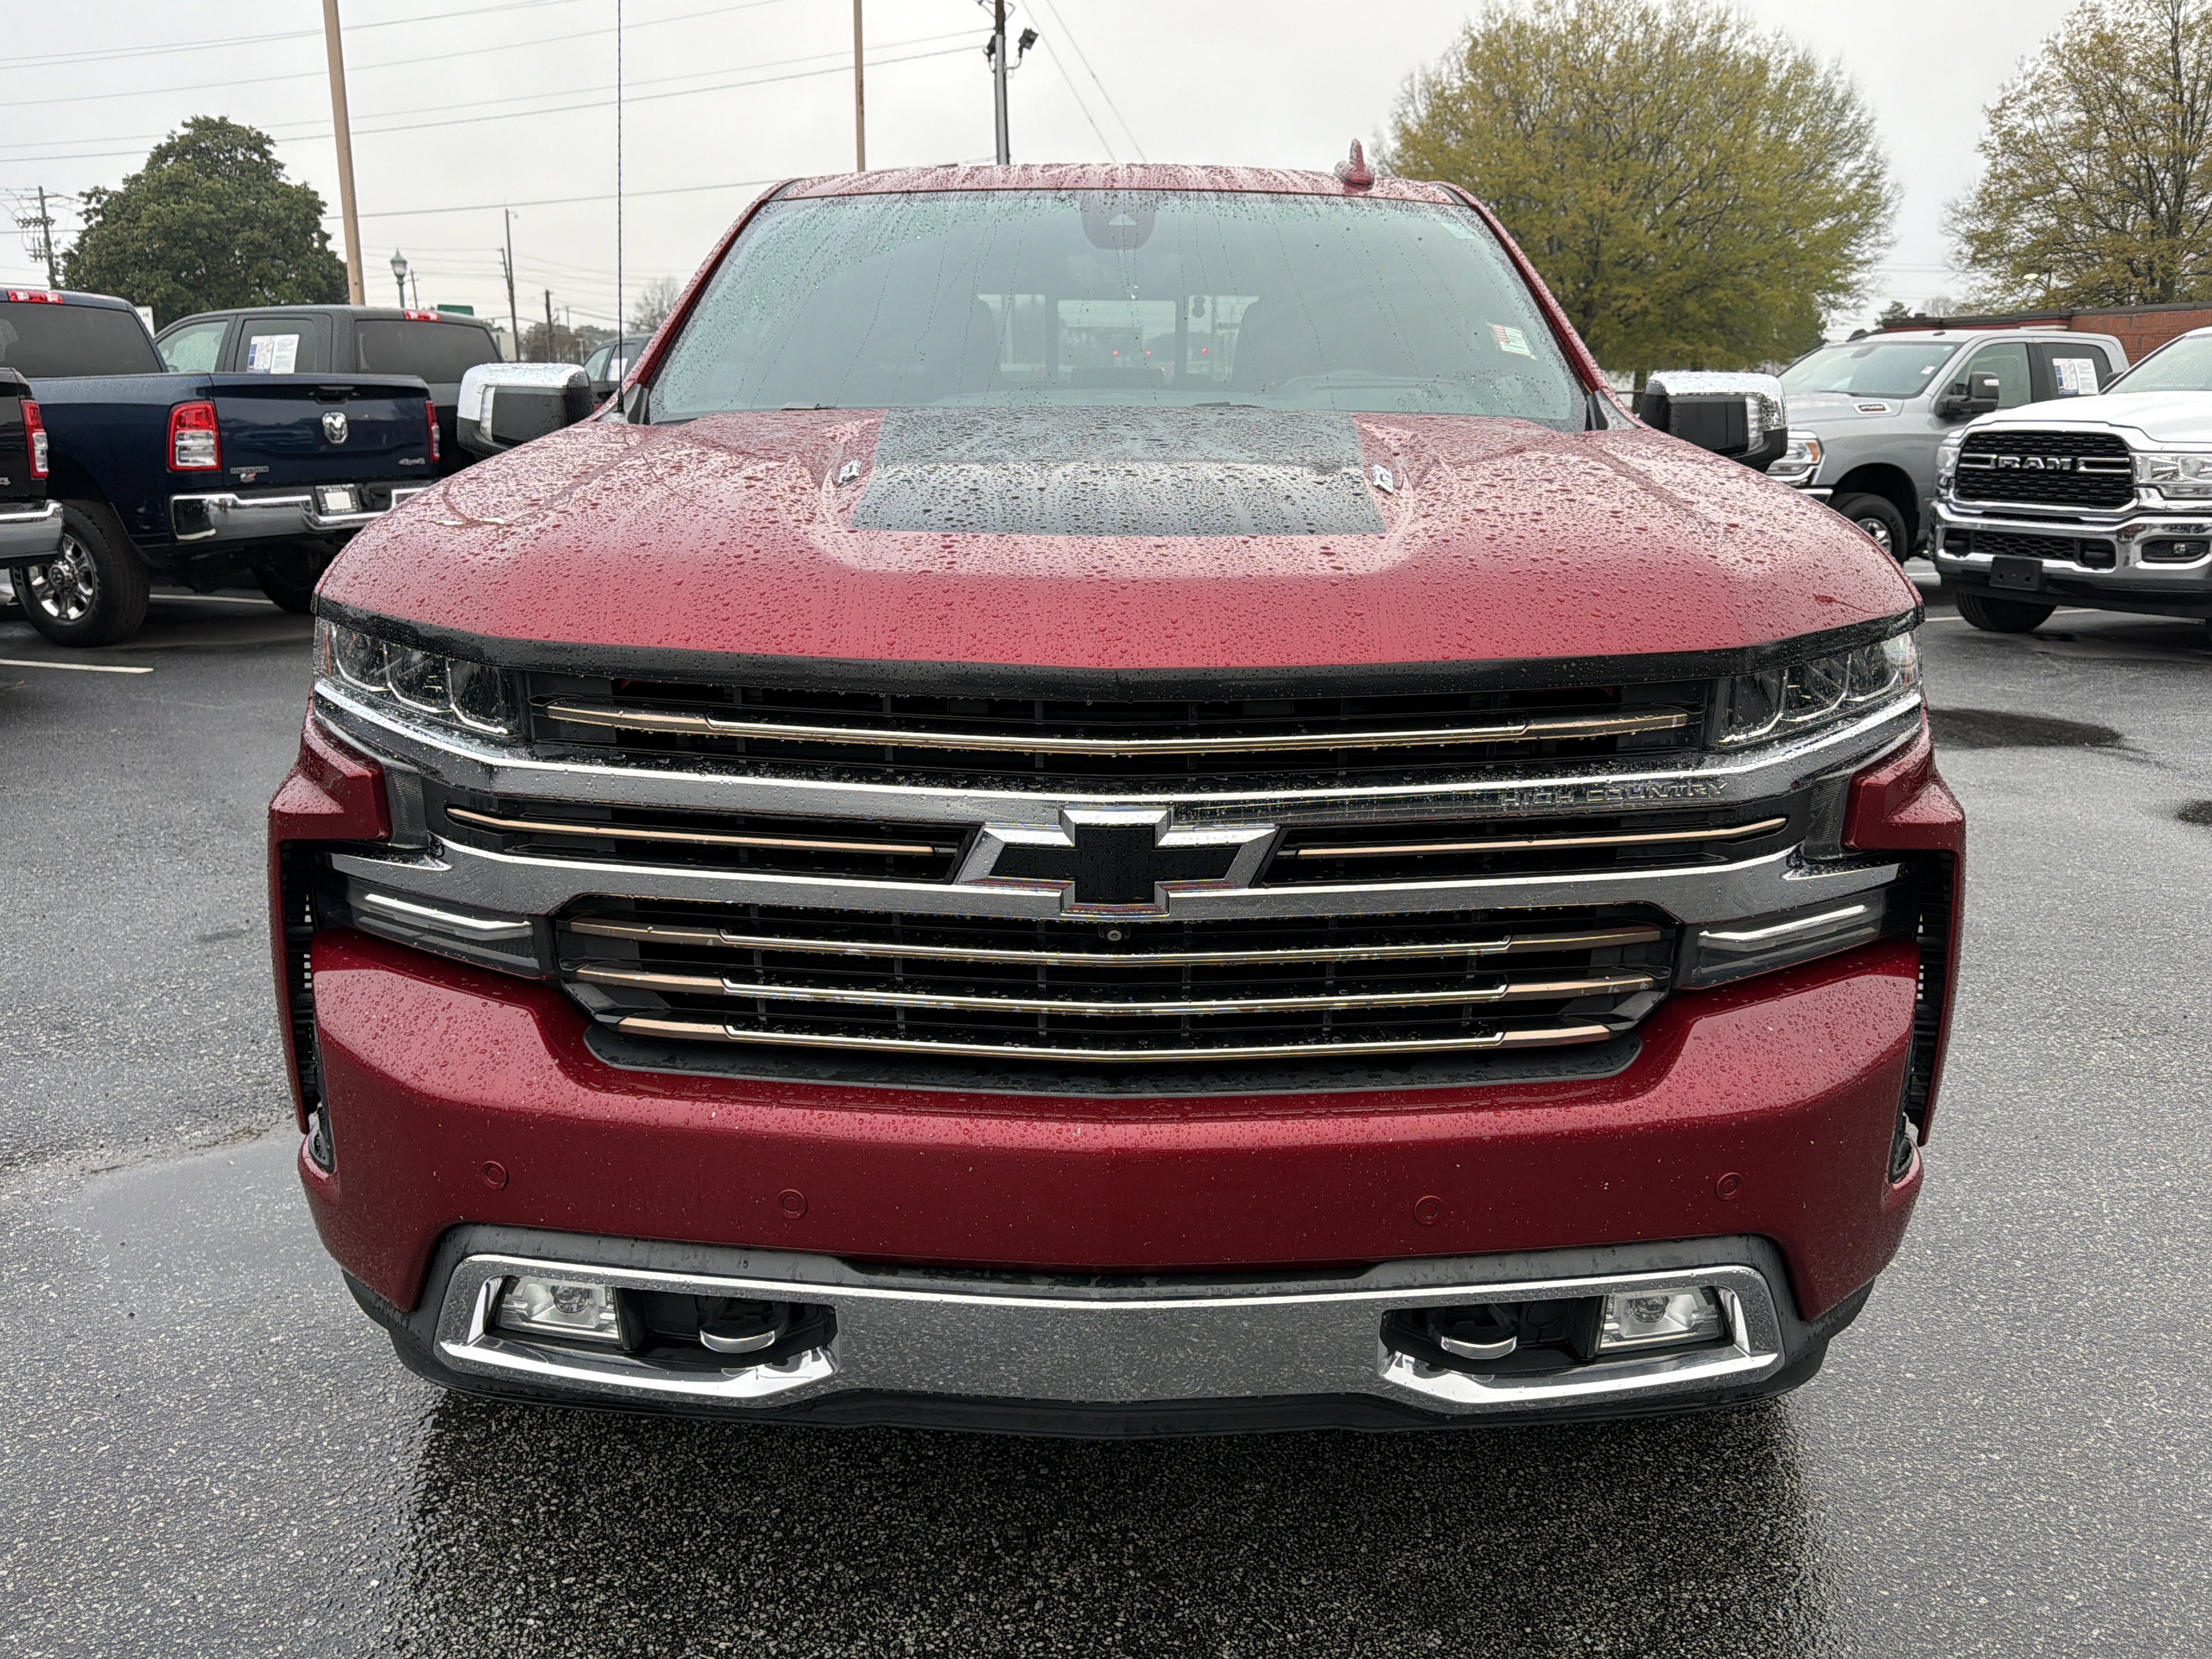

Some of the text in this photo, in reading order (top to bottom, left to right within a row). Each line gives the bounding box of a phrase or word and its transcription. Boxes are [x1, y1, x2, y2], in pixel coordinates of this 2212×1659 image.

[1998, 456, 2072, 470] RAM
[1501, 782, 1728, 806] HIGH COUNTRY
